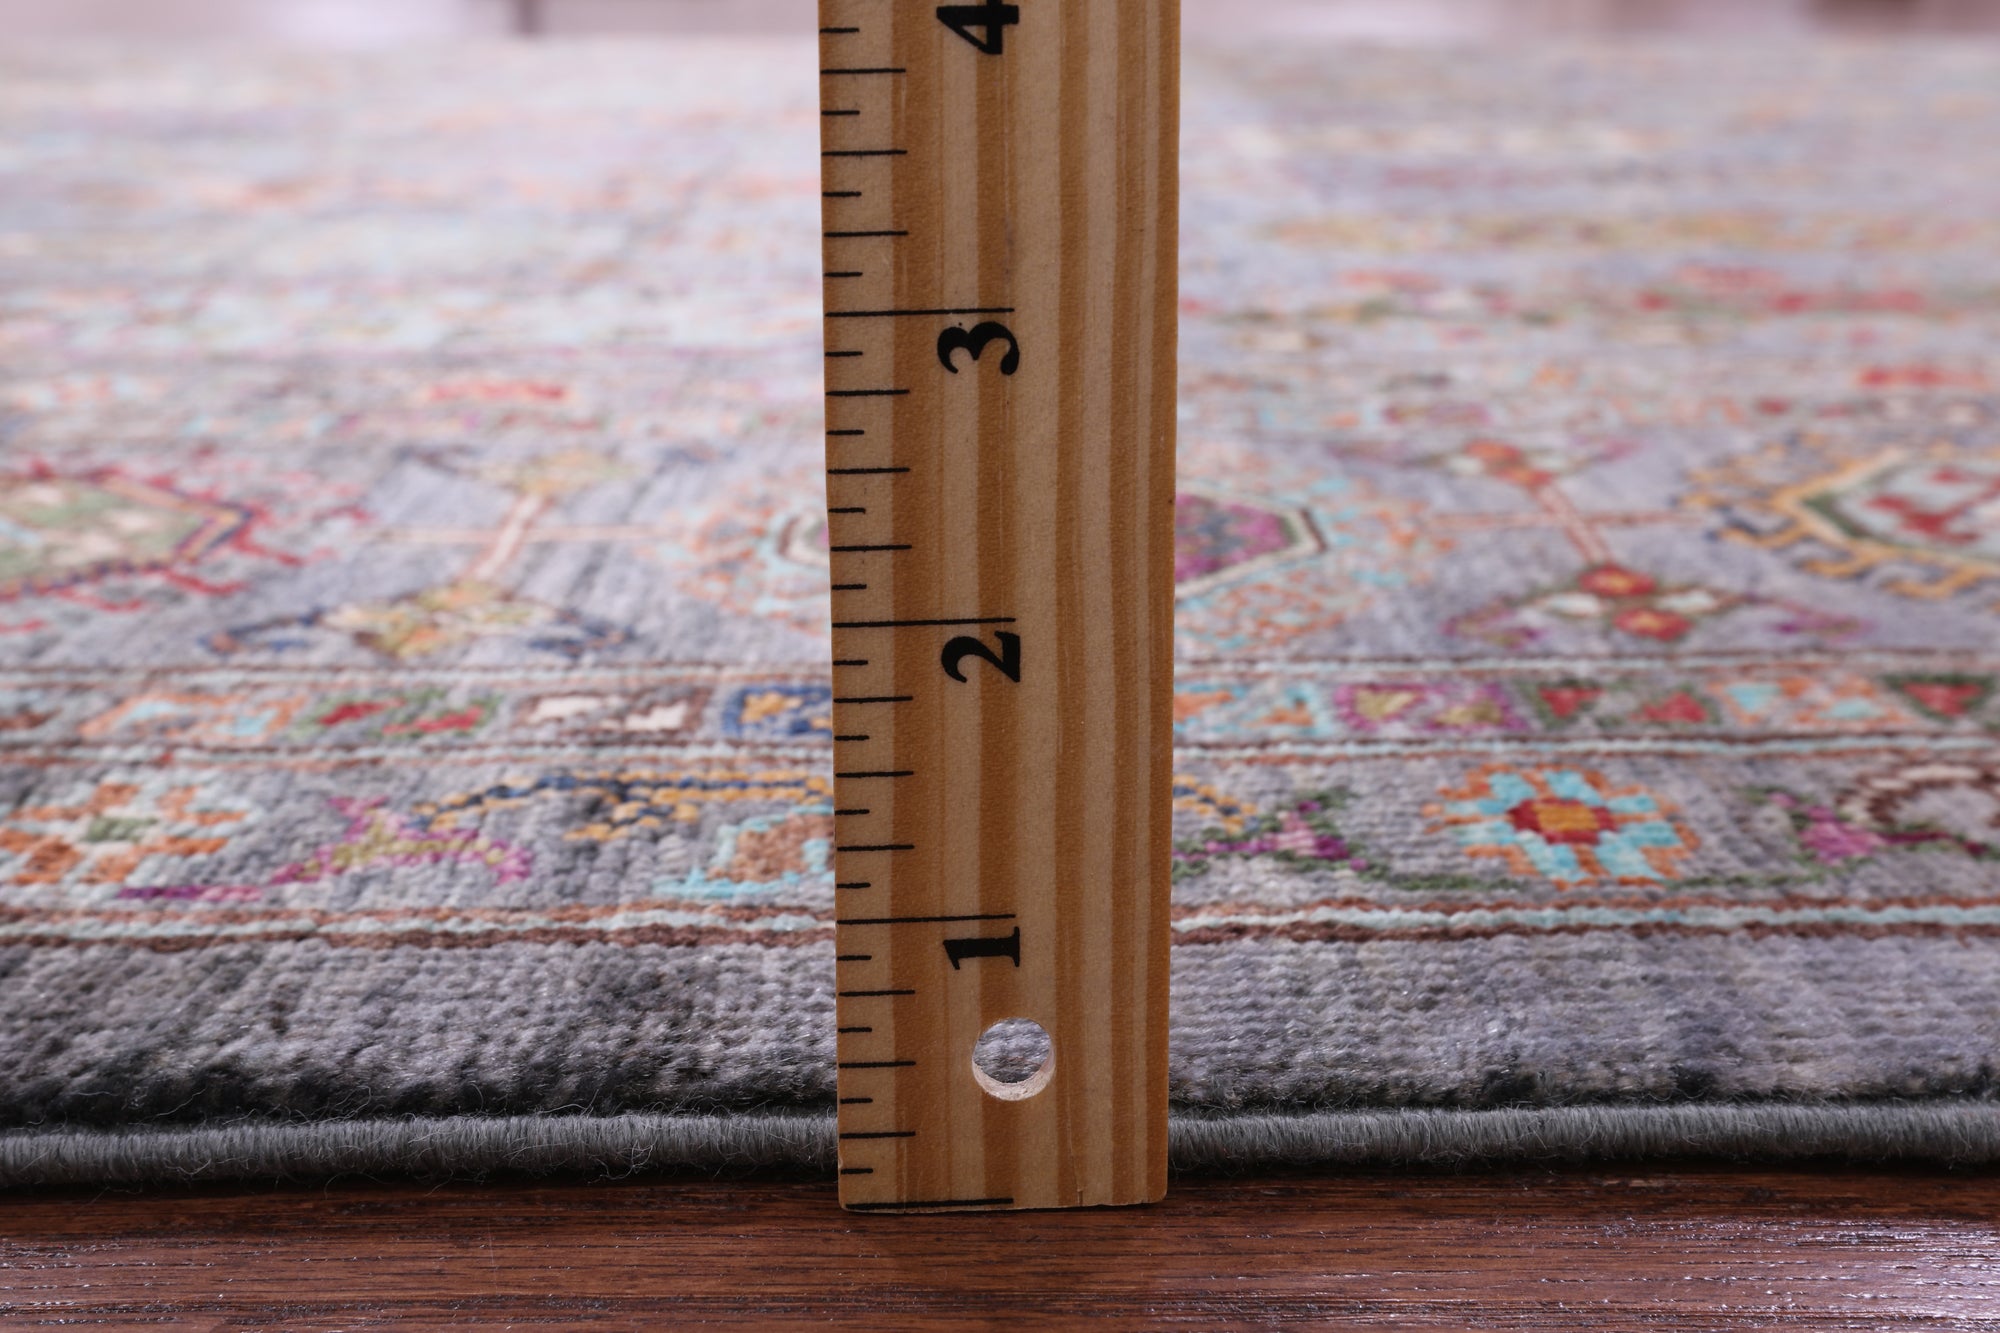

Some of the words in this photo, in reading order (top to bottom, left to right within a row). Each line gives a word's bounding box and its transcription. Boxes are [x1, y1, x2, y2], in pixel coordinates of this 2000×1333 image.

[936, 0, 1019, 55] 4
[937, 321, 1020, 375] 3
[941, 631, 1021, 683] 2
[943, 926, 1020, 970] 1
